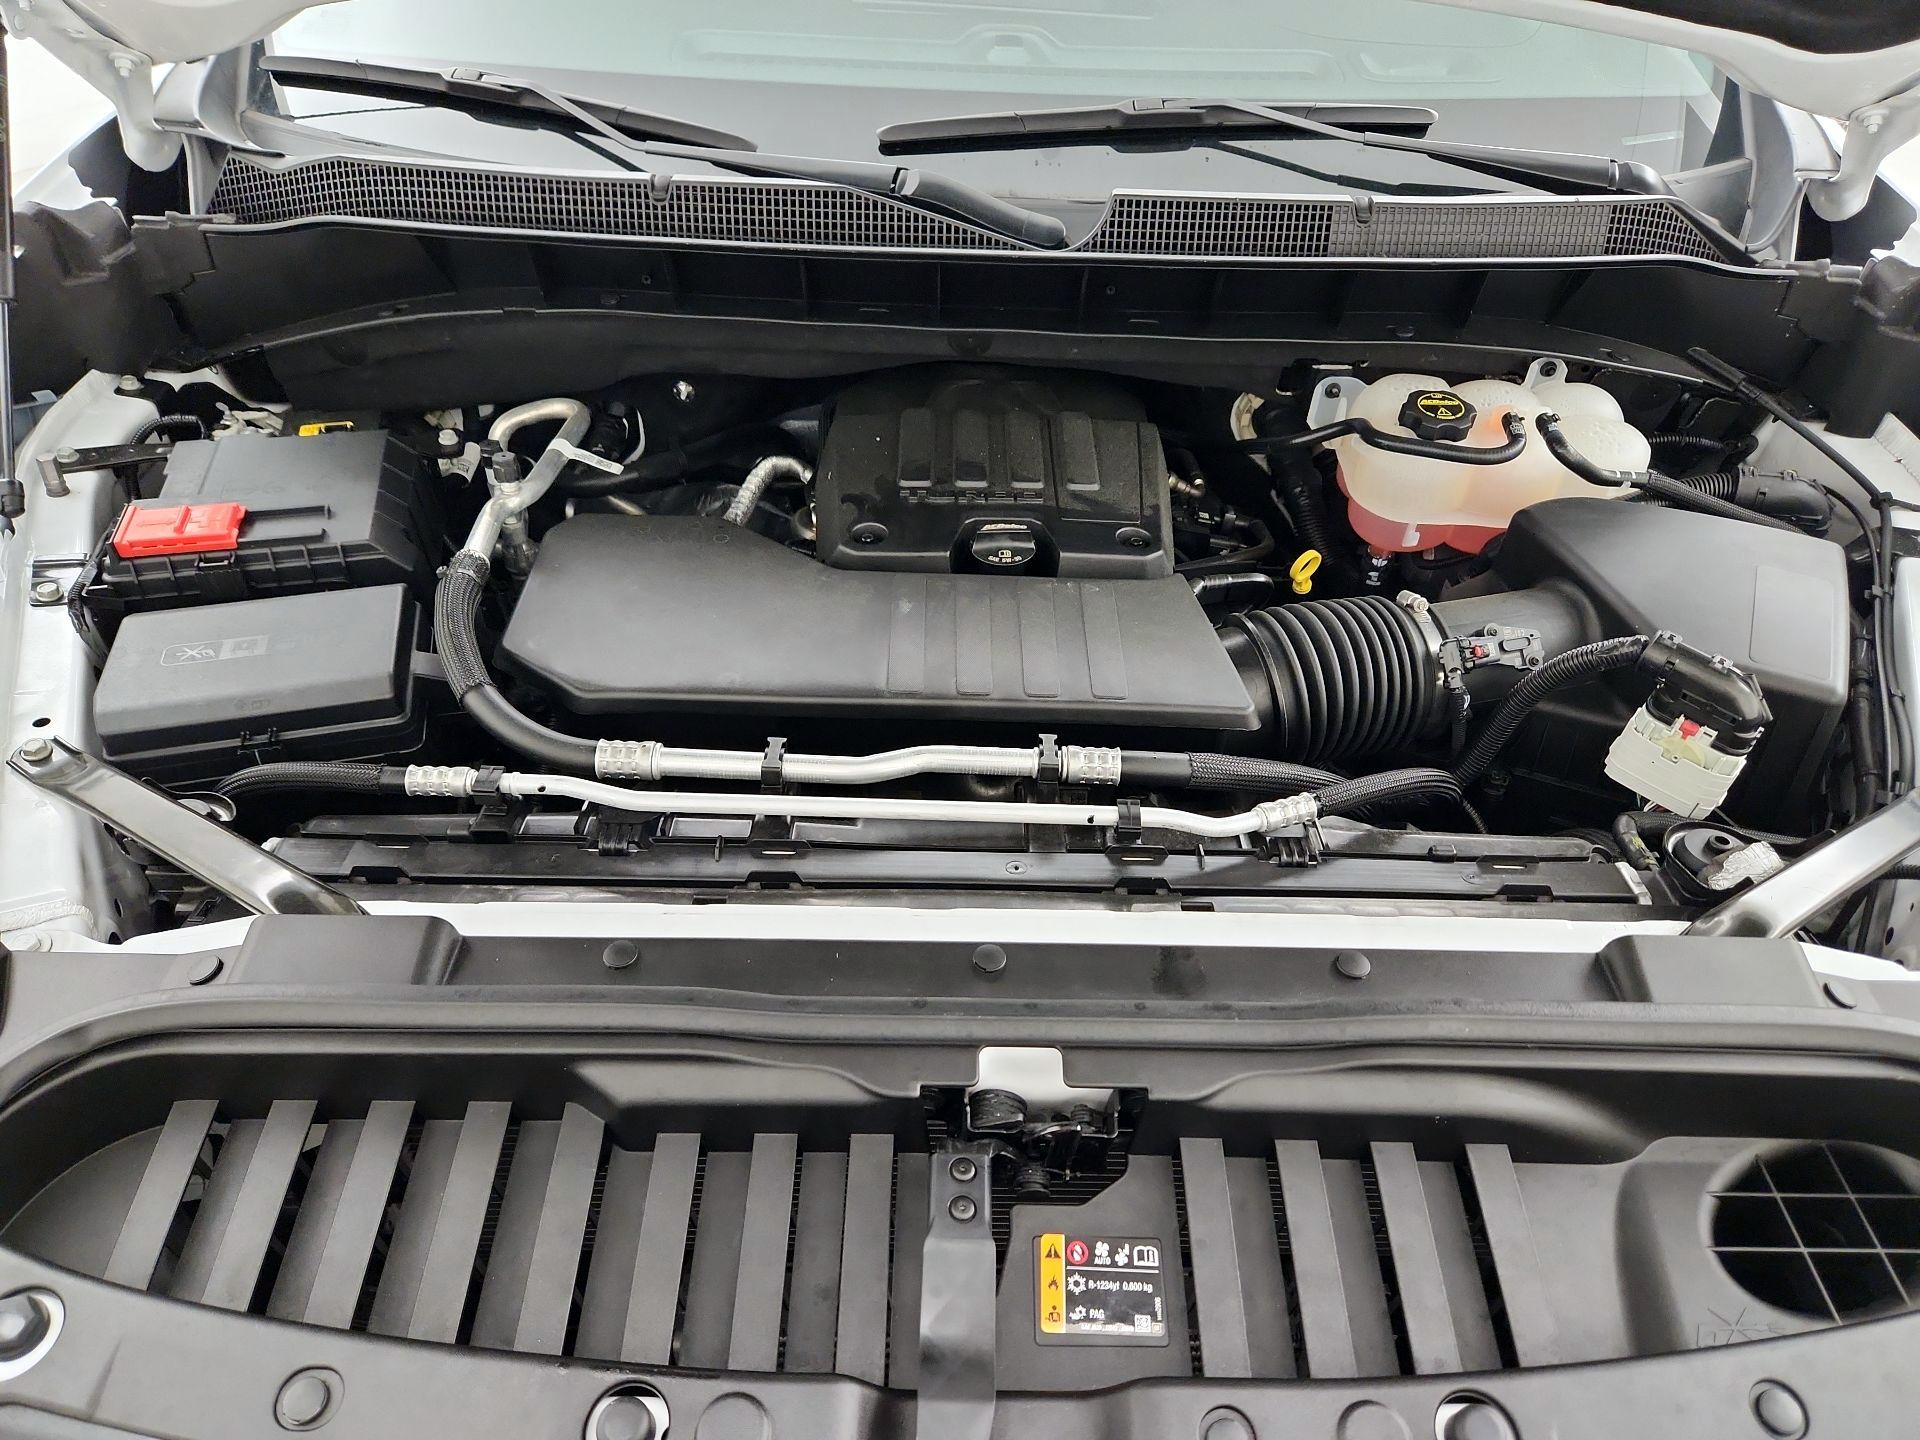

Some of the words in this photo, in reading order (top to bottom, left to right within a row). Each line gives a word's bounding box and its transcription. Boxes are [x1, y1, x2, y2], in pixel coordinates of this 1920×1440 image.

[1094, 1257, 1111, 1265] AUTO
[1143, 1282, 1153, 1293] kg
[1089, 1309, 1105, 1319] PAG
